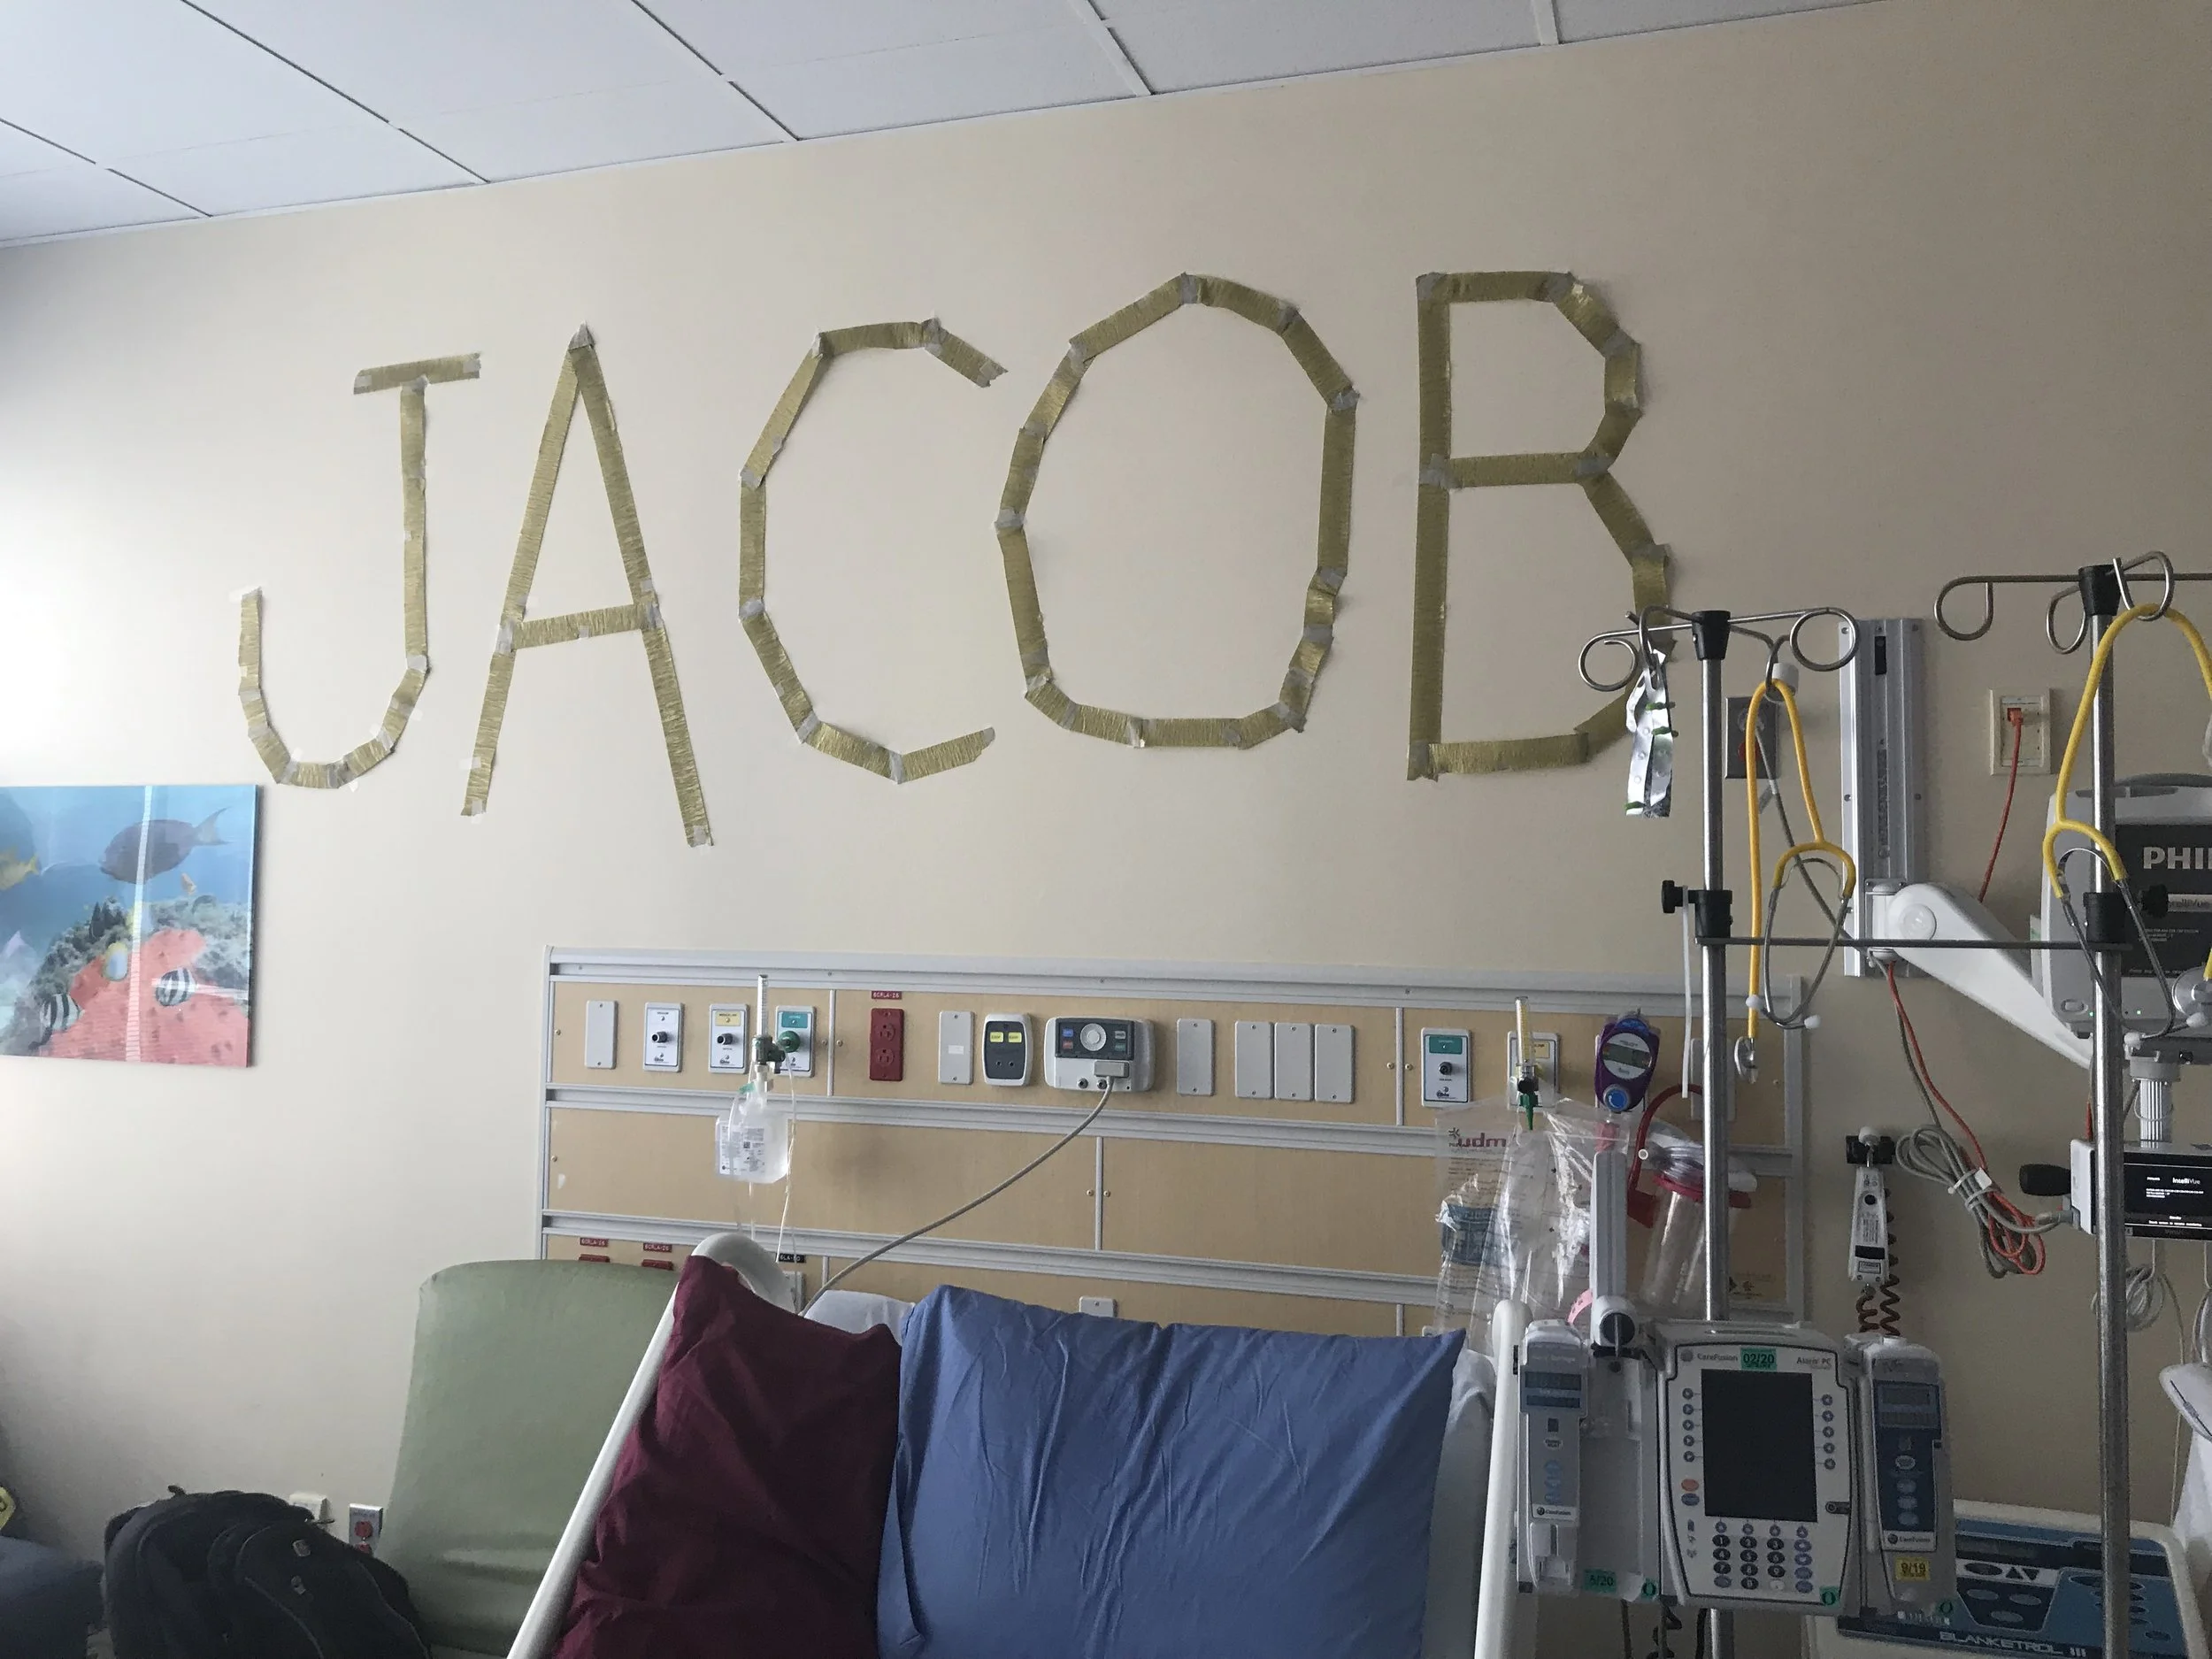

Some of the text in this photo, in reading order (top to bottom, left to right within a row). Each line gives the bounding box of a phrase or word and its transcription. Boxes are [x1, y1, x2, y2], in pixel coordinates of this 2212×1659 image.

[234, 272, 1675, 847] JACOB
[2143, 846, 2212, 870] PHI
[1697, 1353, 1739, 1363] CareFusion
[1743, 1353, 1776, 1364] 02/20
[1939, 1631, 2064, 1655] BLANKETROL
